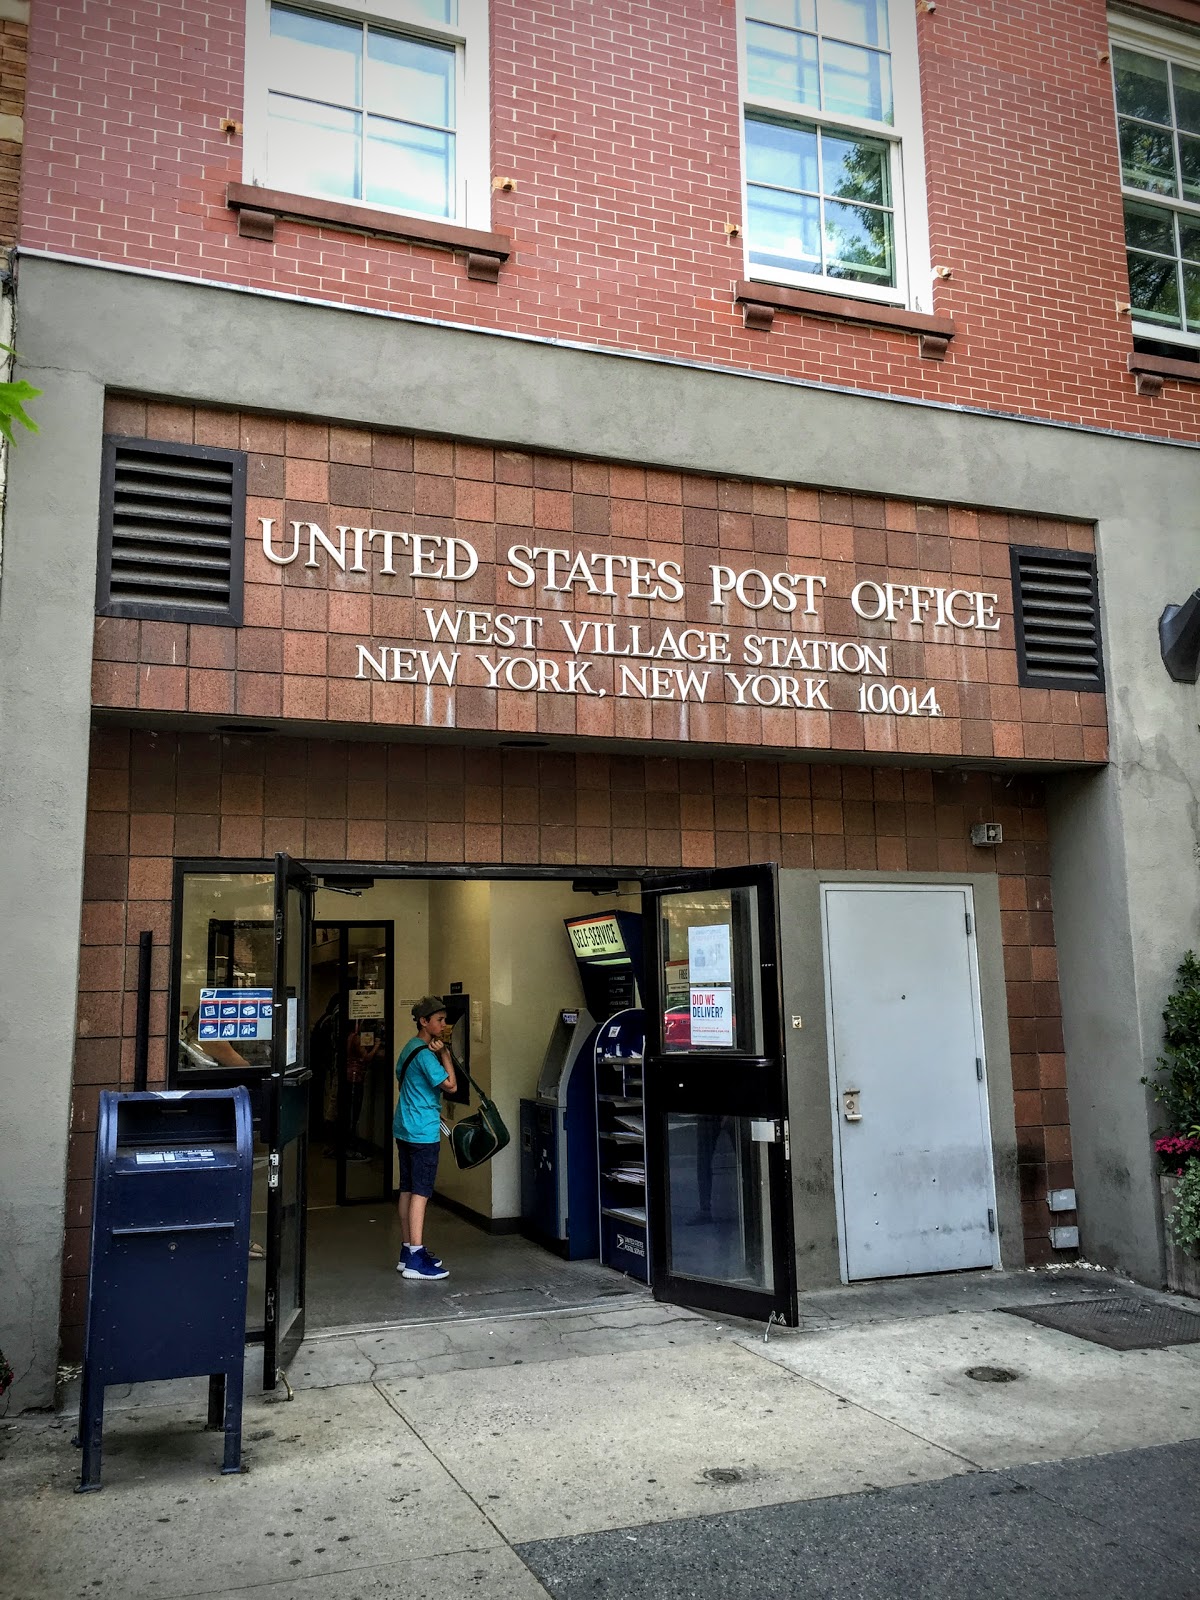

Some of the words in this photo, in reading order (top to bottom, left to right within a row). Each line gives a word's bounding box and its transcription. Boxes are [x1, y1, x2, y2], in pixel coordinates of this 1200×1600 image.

[257, 516, 479, 580] UNITED
[507, 545, 684, 602] STATES
[709, 565, 827, 615] POST
[851, 581, 1001, 631] OFFICE
[422, 607, 542, 649] WEST
[559, 620, 731, 664] VILLAGE
[743, 634, 888, 677] STATION
[355, 645, 461, 687] NEW
[475, 654, 606, 698] YORK,
[619, 664, 710, 703] NEW
[725, 672, 833, 710] YORK
[858, 682, 942, 717] 10014
[573, 923, 618, 949] SELF-SERVICE
[692, 994, 704, 1006] DID
[705, 994, 716, 1006] WE
[692, 1006, 724, 1018] DELIVER?
